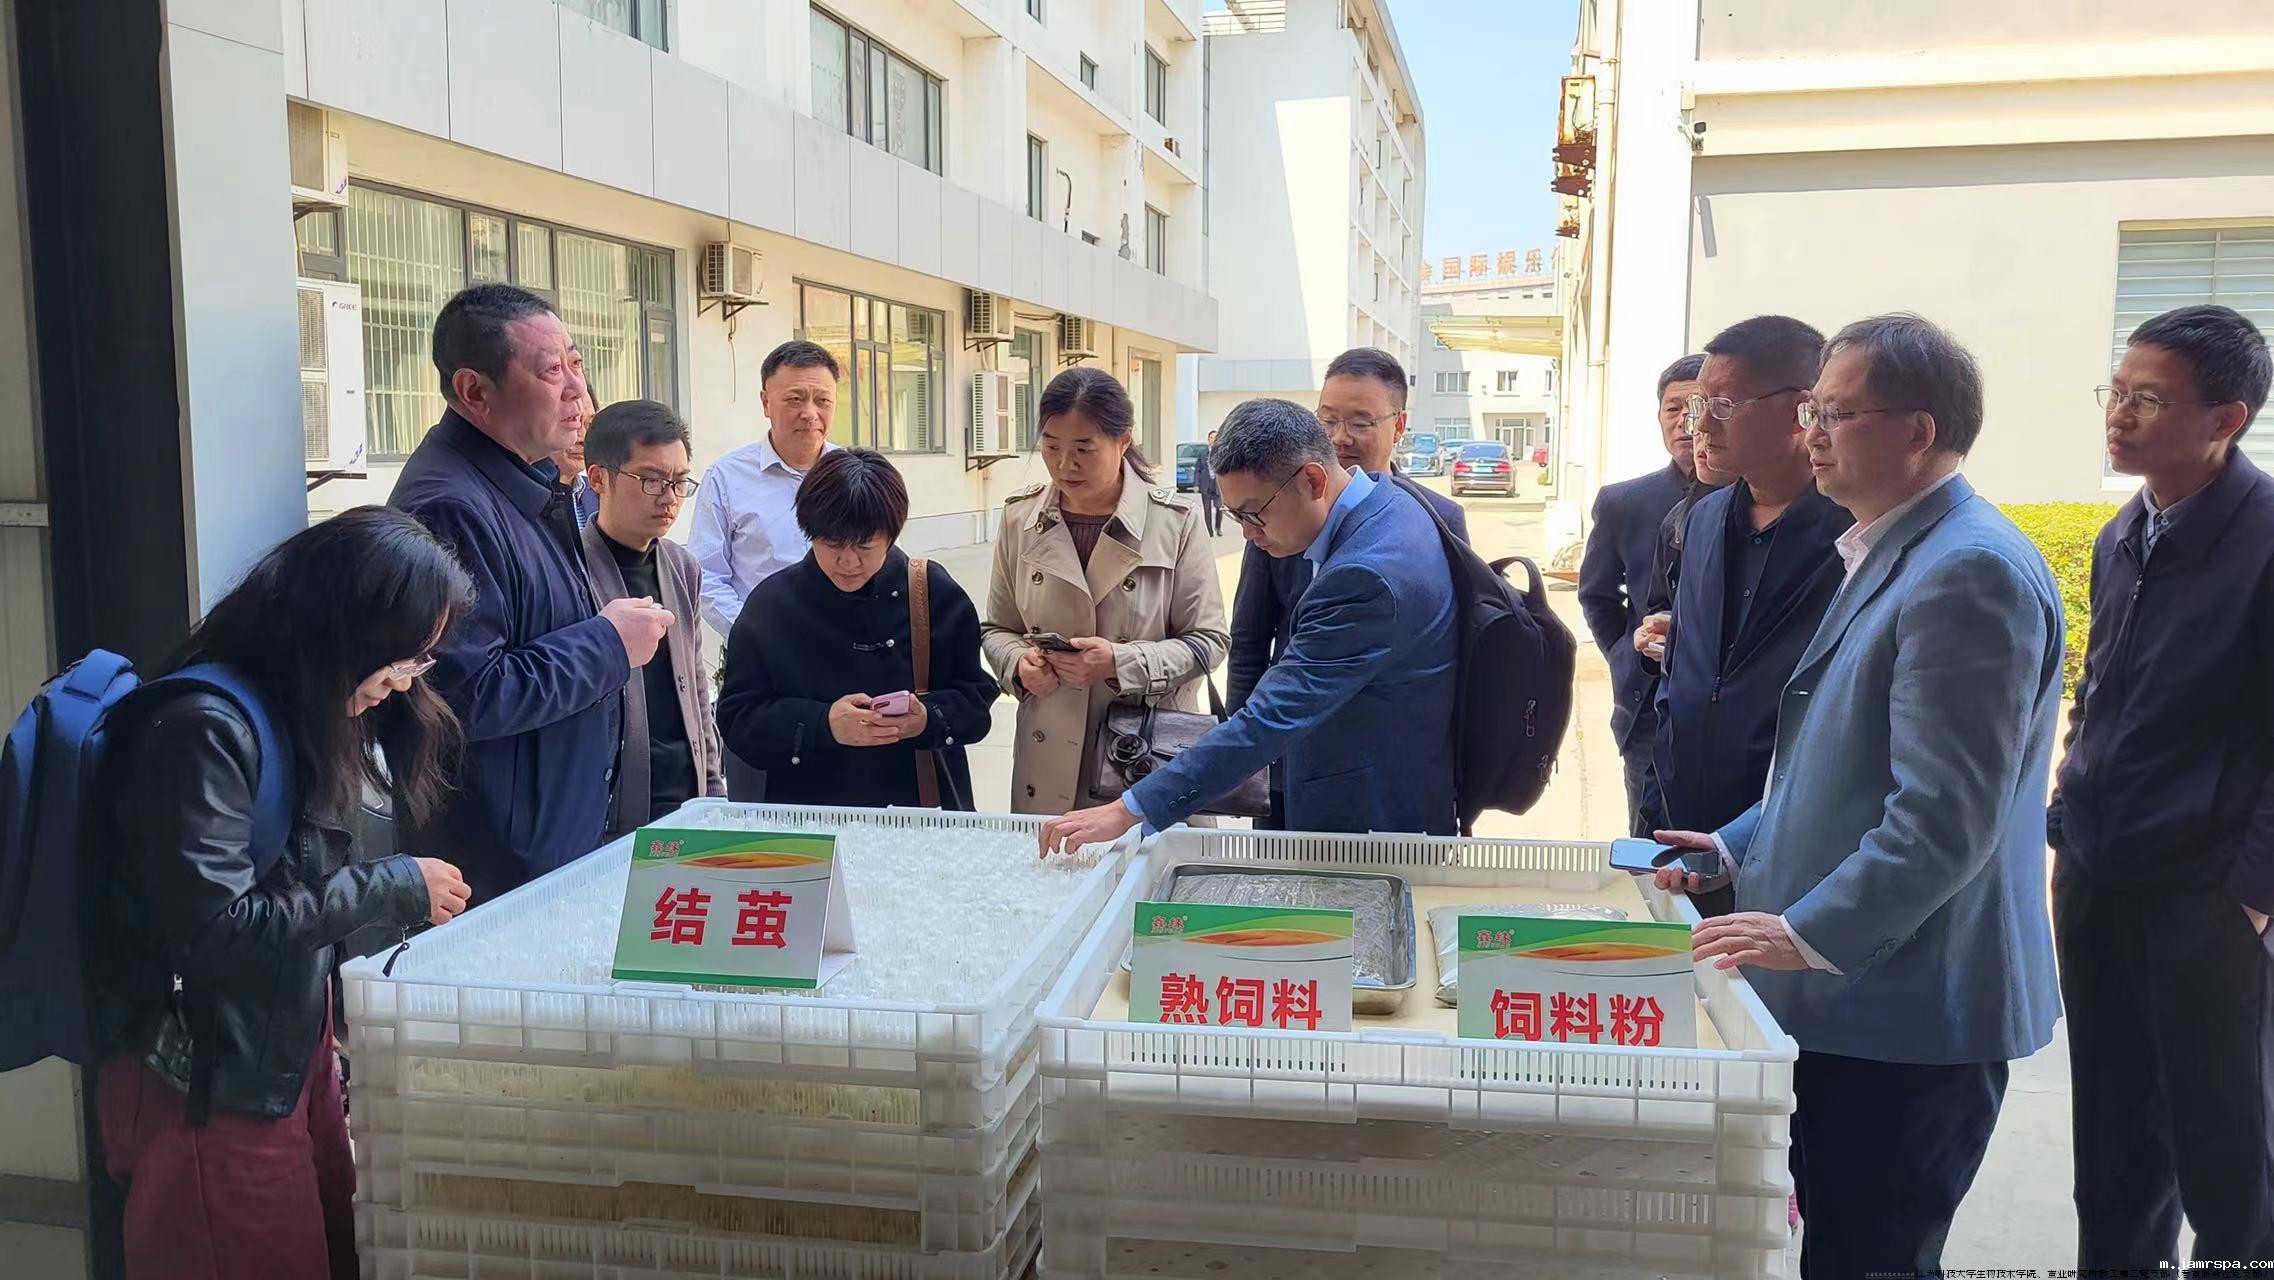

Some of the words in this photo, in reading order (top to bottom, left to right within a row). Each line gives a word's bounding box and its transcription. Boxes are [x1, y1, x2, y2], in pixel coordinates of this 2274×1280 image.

[1421, 248, 1556, 281] 国际娱乐
[650, 886, 793, 949] 结茧
[1159, 972, 1322, 1031] 熟饲料
[1490, 988, 1664, 1047] 饲料粉
